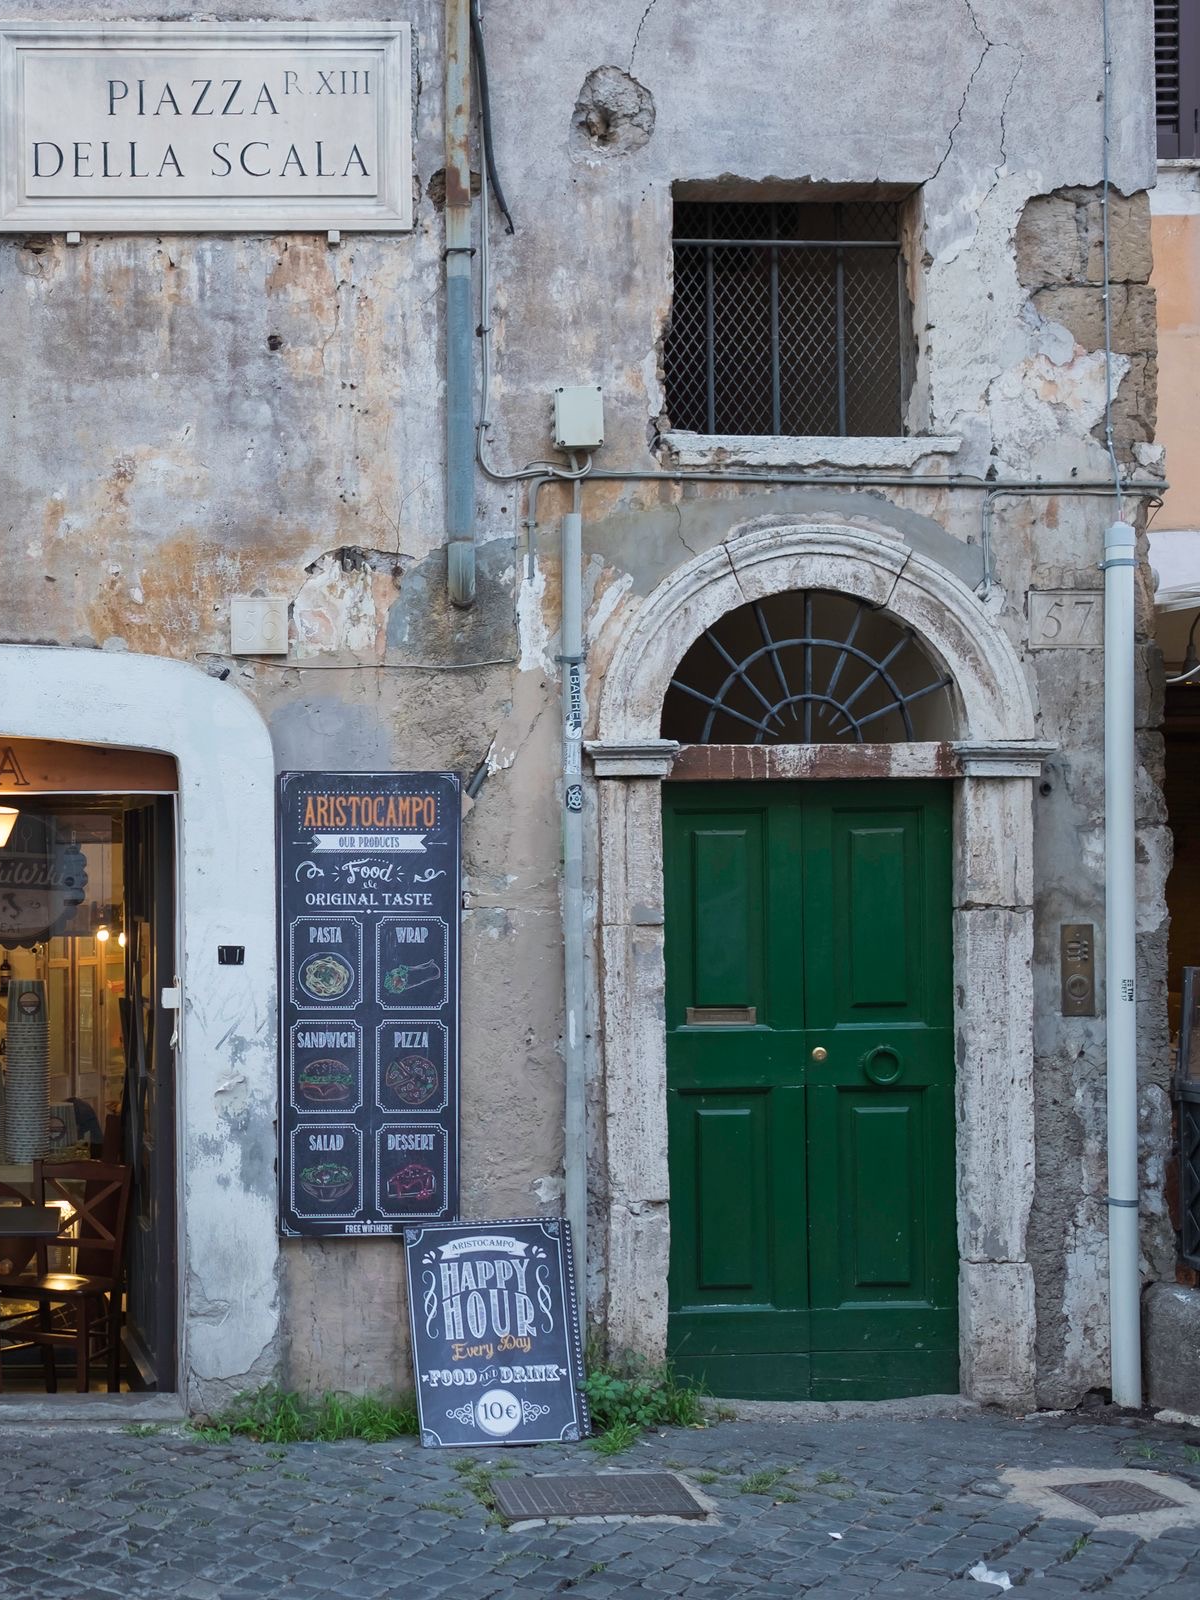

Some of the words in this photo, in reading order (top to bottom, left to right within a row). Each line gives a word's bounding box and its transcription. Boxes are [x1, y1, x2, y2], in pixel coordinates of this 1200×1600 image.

[106, 79, 280, 116] PIAZZA
[31, 141, 184, 178] DELLA
[210, 140, 371, 178] SCALA
[237, 608, 281, 642] 56
[1041, 601, 1095, 639] 57
[303, 795, 436, 827] ARISTOCAMPO
[338, 836, 356, 848] OUR
[358, 836, 400, 848] PRODUCTS
[341, 858, 393, 884] Food
[305, 893, 379, 906] ORIGINAL
[382, 893, 433, 906] TASTE
[0, 922, 23, 934] EAT
[309, 926, 343, 944] PASTA
[395, 926, 429, 944] WRAP
[297, 1031, 356, 1049] SANDWICH
[394, 1031, 429, 1048] PIZZA
[309, 1134, 344, 1151] SALAD
[387, 1134, 435, 1151] DESSERT
[345, 1224, 361, 1233] FREE
[376, 1224, 393, 1233] HERE
[451, 1238, 515, 1251] ARISTOCAMPO
[439, 1258, 530, 1300] HAPPY
[442, 1288, 537, 1341] HOUR
[451, 1343, 494, 1361] Every
[497, 1333, 531, 1354] Day
[428, 1369, 477, 1387] FOOD
[478, 1369, 498, 1382] AND
[499, 1364, 560, 1384] DRINK
[481, 1402, 518, 1420] 10€
